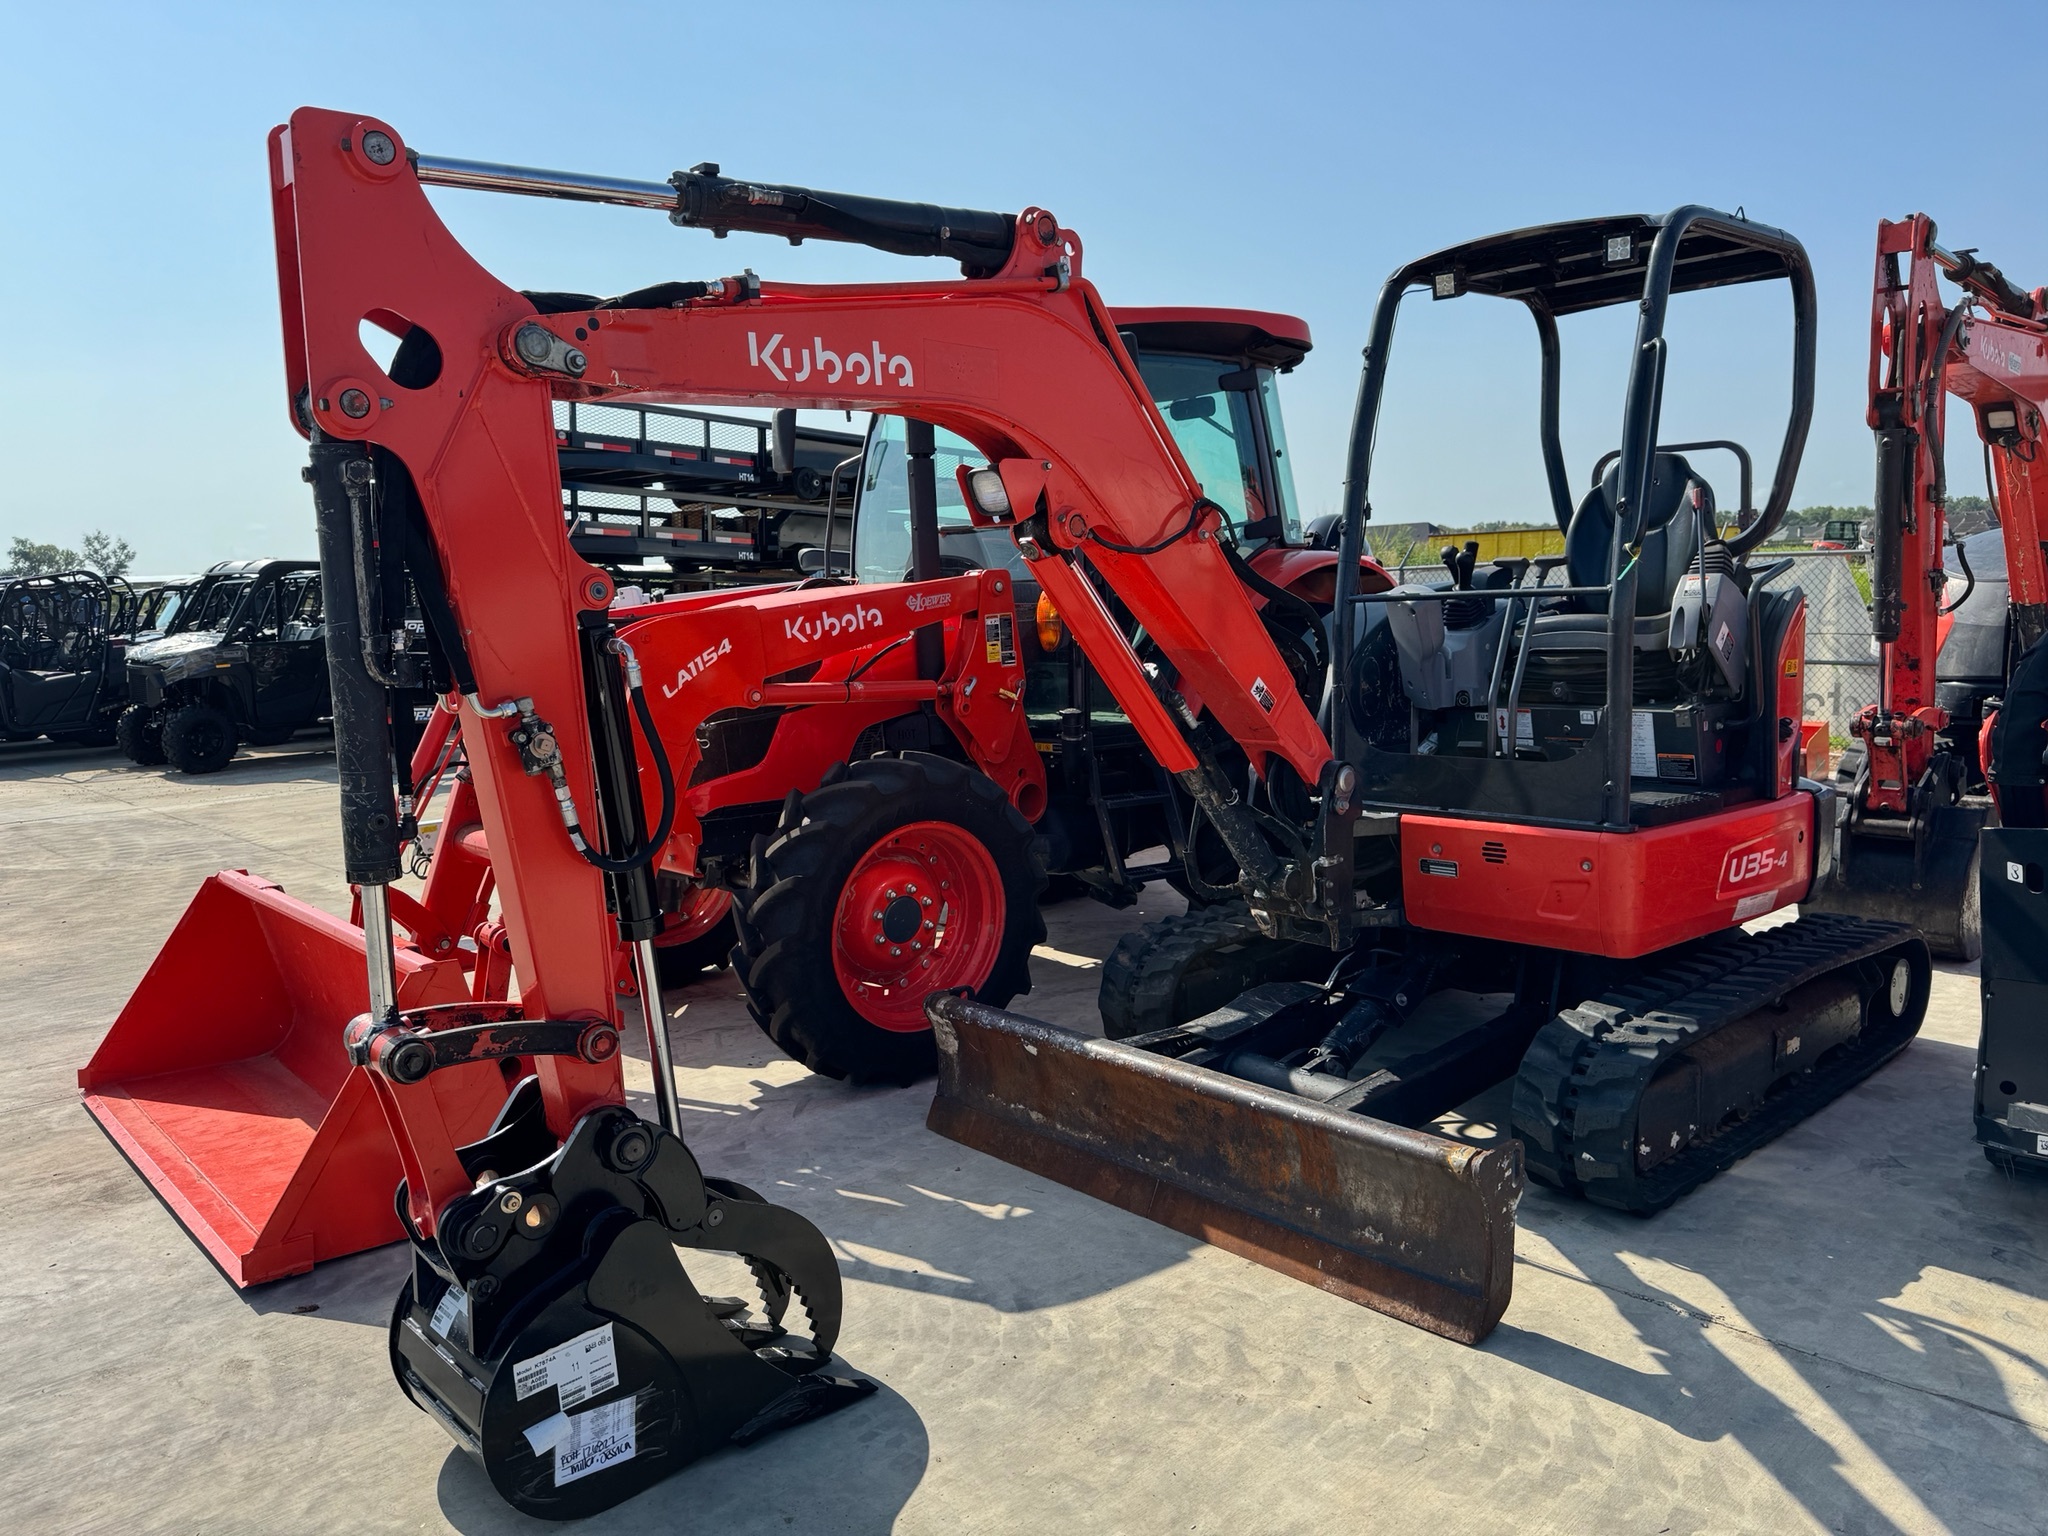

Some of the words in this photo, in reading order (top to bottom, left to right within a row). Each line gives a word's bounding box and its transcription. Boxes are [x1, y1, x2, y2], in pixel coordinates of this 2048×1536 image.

[748, 331, 914, 387] Kubota
[1981, 336, 2006, 367] Kubota
[784, 604, 884, 643] Kubota
[662, 637, 733, 699] LA1154
[1729, 848, 1788, 883] U35-4
